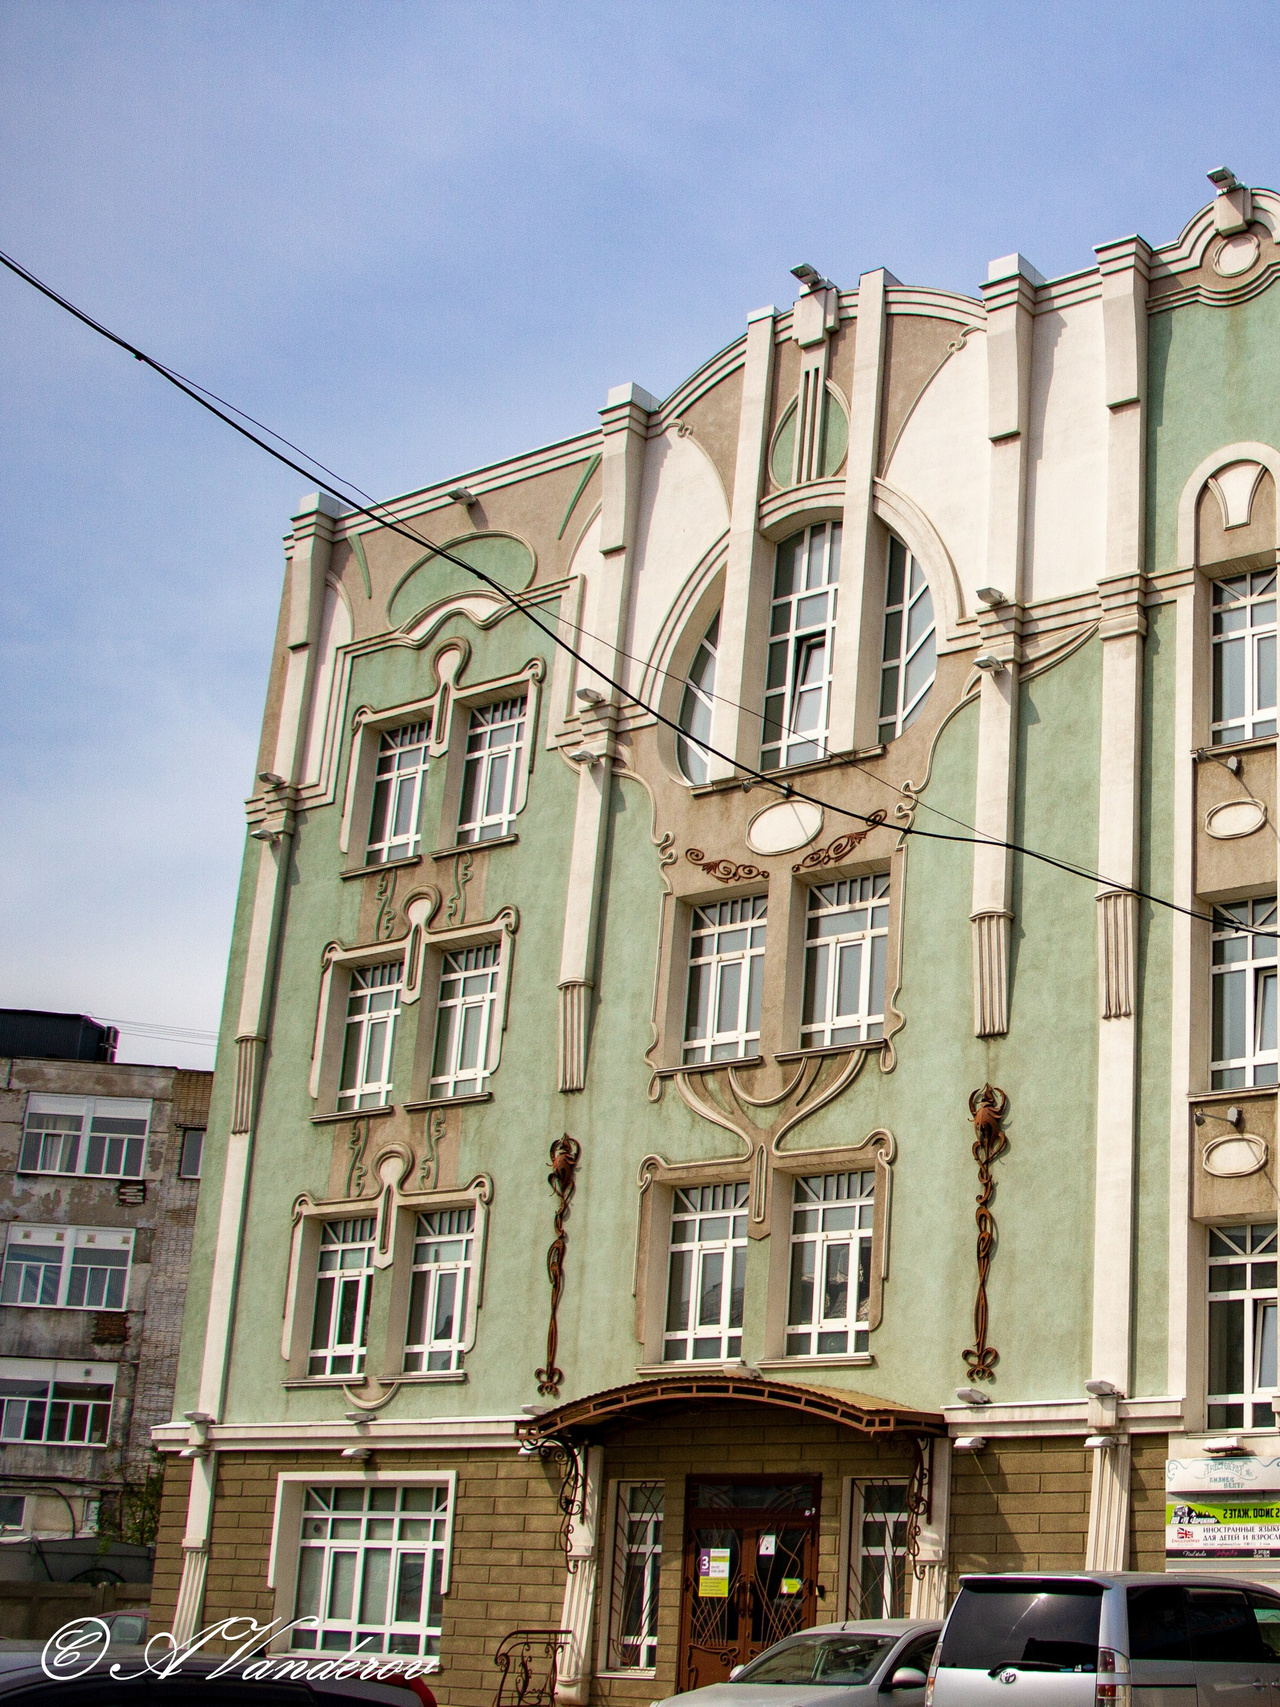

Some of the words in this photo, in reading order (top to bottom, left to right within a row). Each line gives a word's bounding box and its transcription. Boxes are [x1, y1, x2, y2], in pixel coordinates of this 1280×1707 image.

[1223, 1508, 1228, 1519] 2
[1228, 1508, 1252, 1519] ЭТАЖ,
[1253, 1507, 1275, 1519] ОФИС
[1203, 1526, 1255, 1534] ИНОСТРАННЫЕ
[1219, 1533, 1240, 1541] ДЕТЕЙ
[701, 1556, 709, 1569] 3
